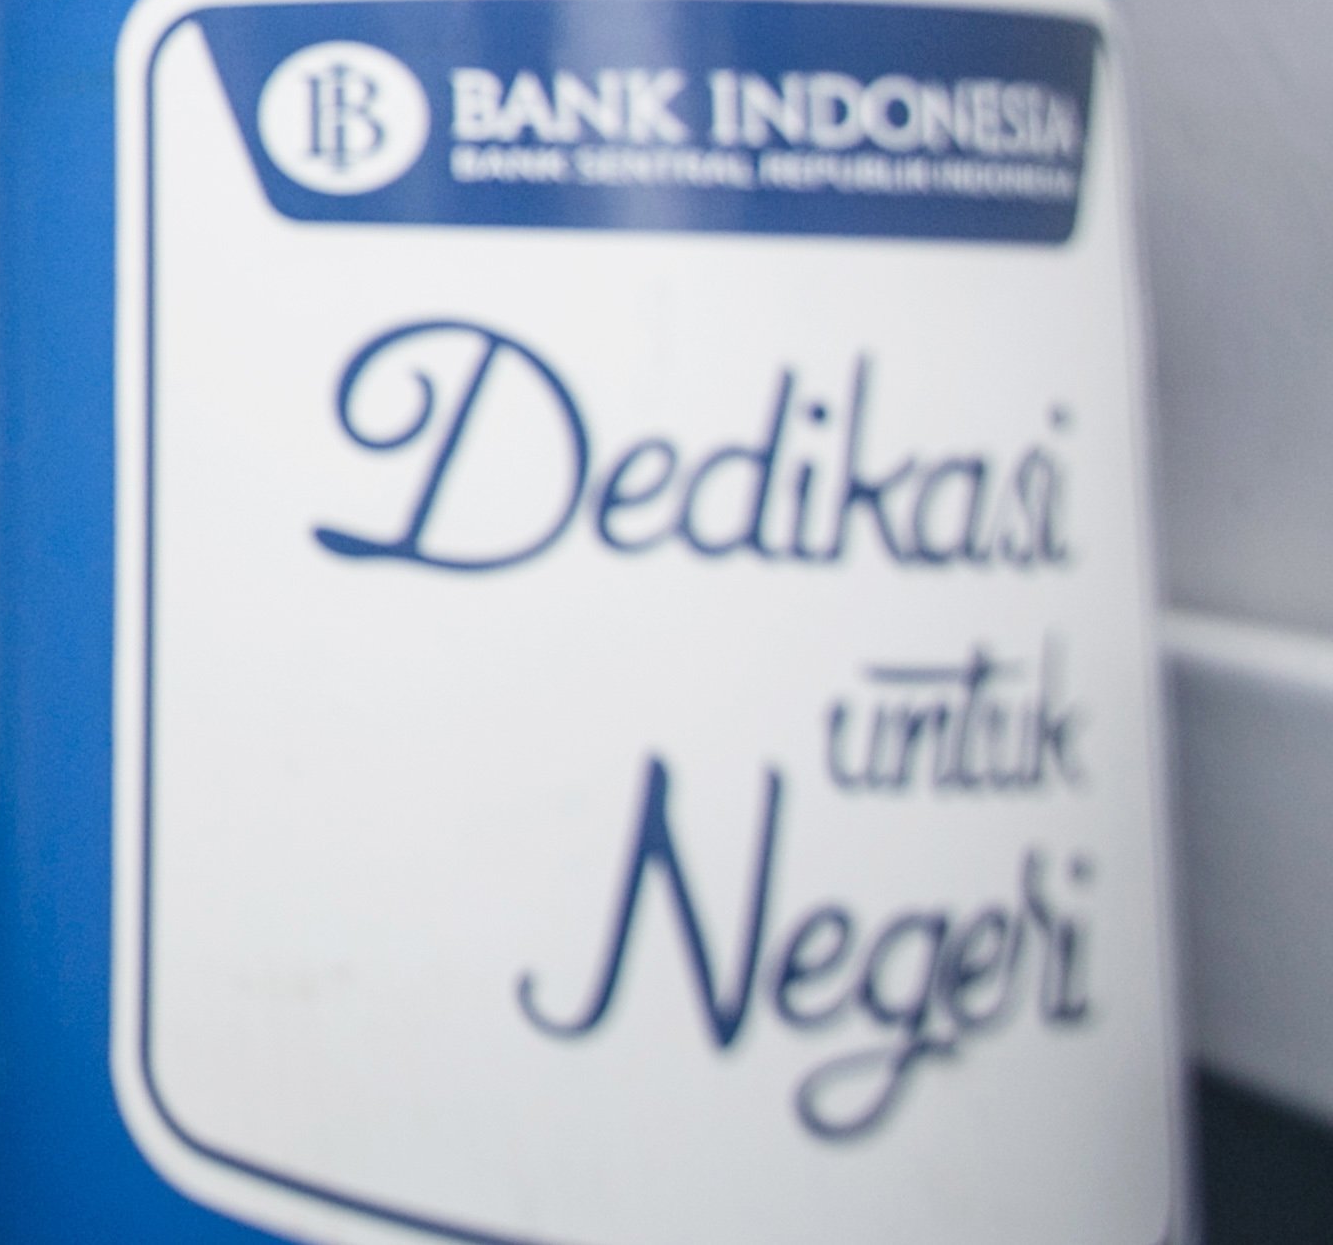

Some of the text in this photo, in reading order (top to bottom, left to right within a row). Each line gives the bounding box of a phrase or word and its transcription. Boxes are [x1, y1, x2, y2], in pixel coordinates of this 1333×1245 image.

[449, 66, 1081, 158] BANK INDONESIA
[309, 318, 1071, 572] Dedikasi
[823, 632, 1088, 796] untuk
[516, 746, 1097, 1142] Negeri
